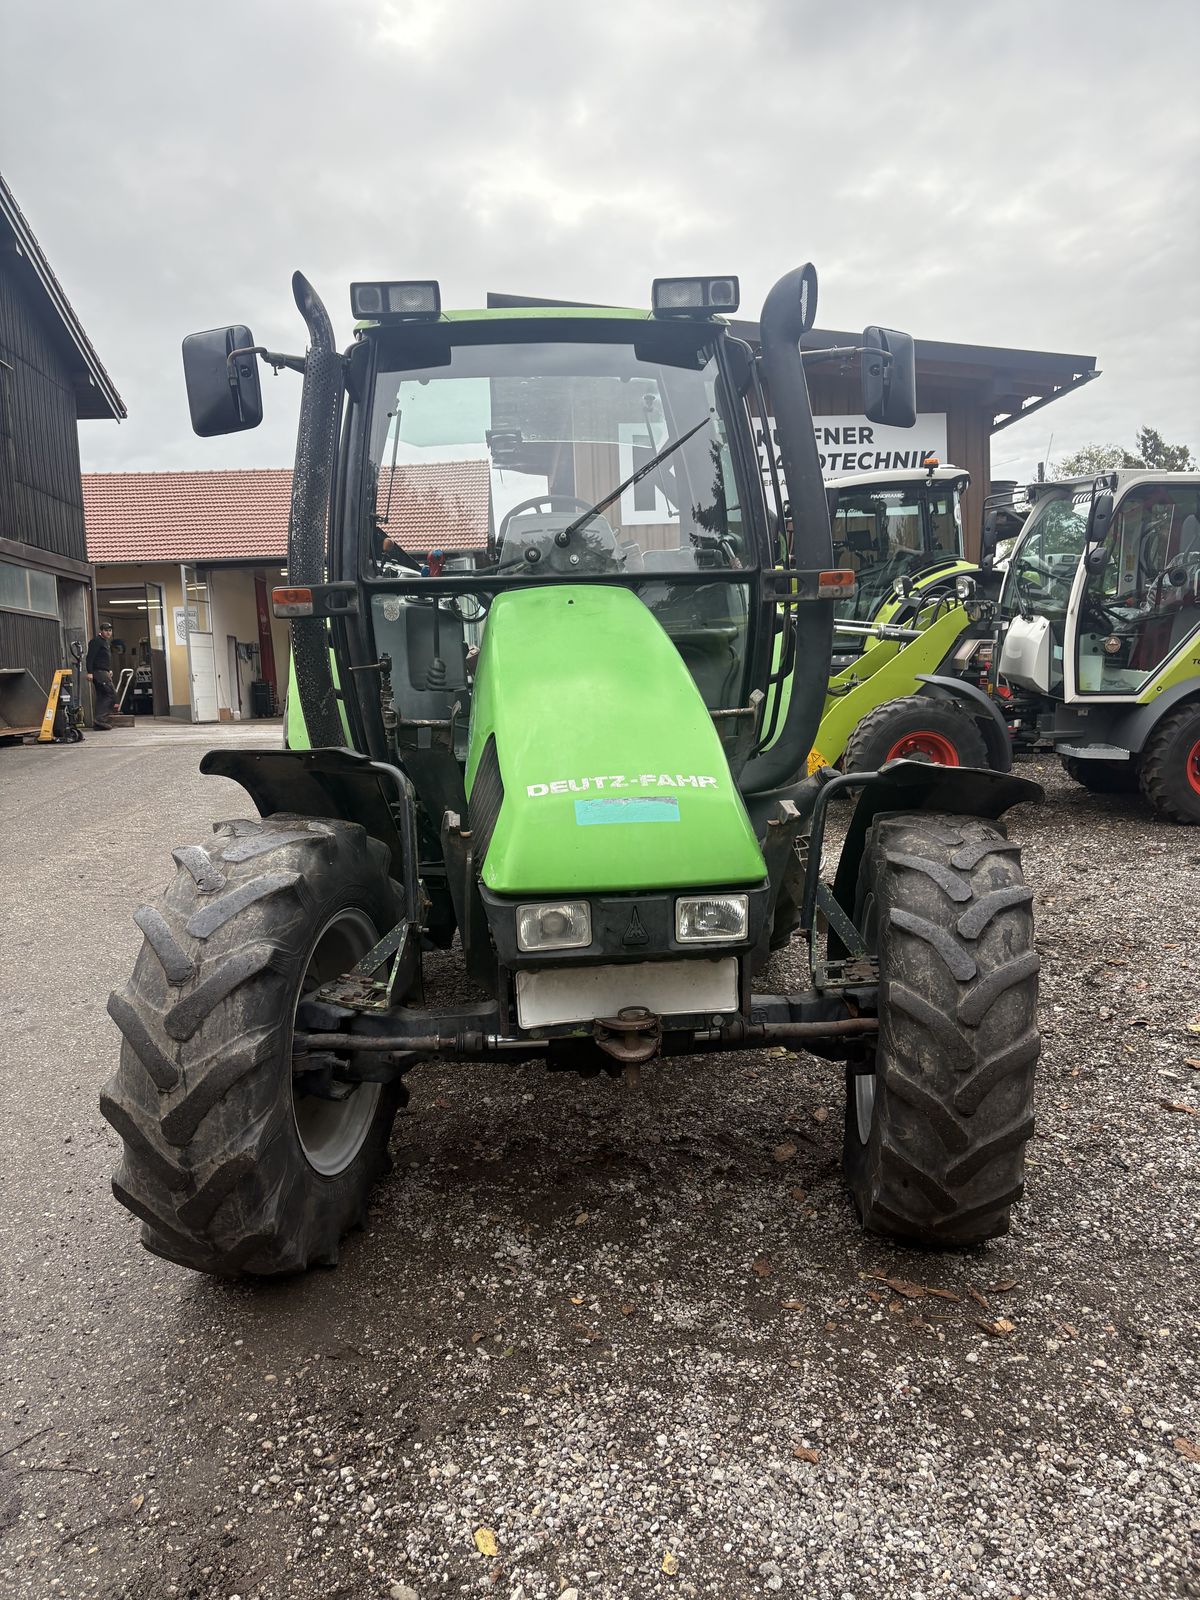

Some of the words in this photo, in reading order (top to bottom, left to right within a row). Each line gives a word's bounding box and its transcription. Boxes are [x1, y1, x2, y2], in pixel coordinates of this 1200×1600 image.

[759, 450, 936, 473] LTECHNIK
[870, 492, 905, 500] PANORAMIC
[527, 774, 719, 798] DEUTZ-FAHR
